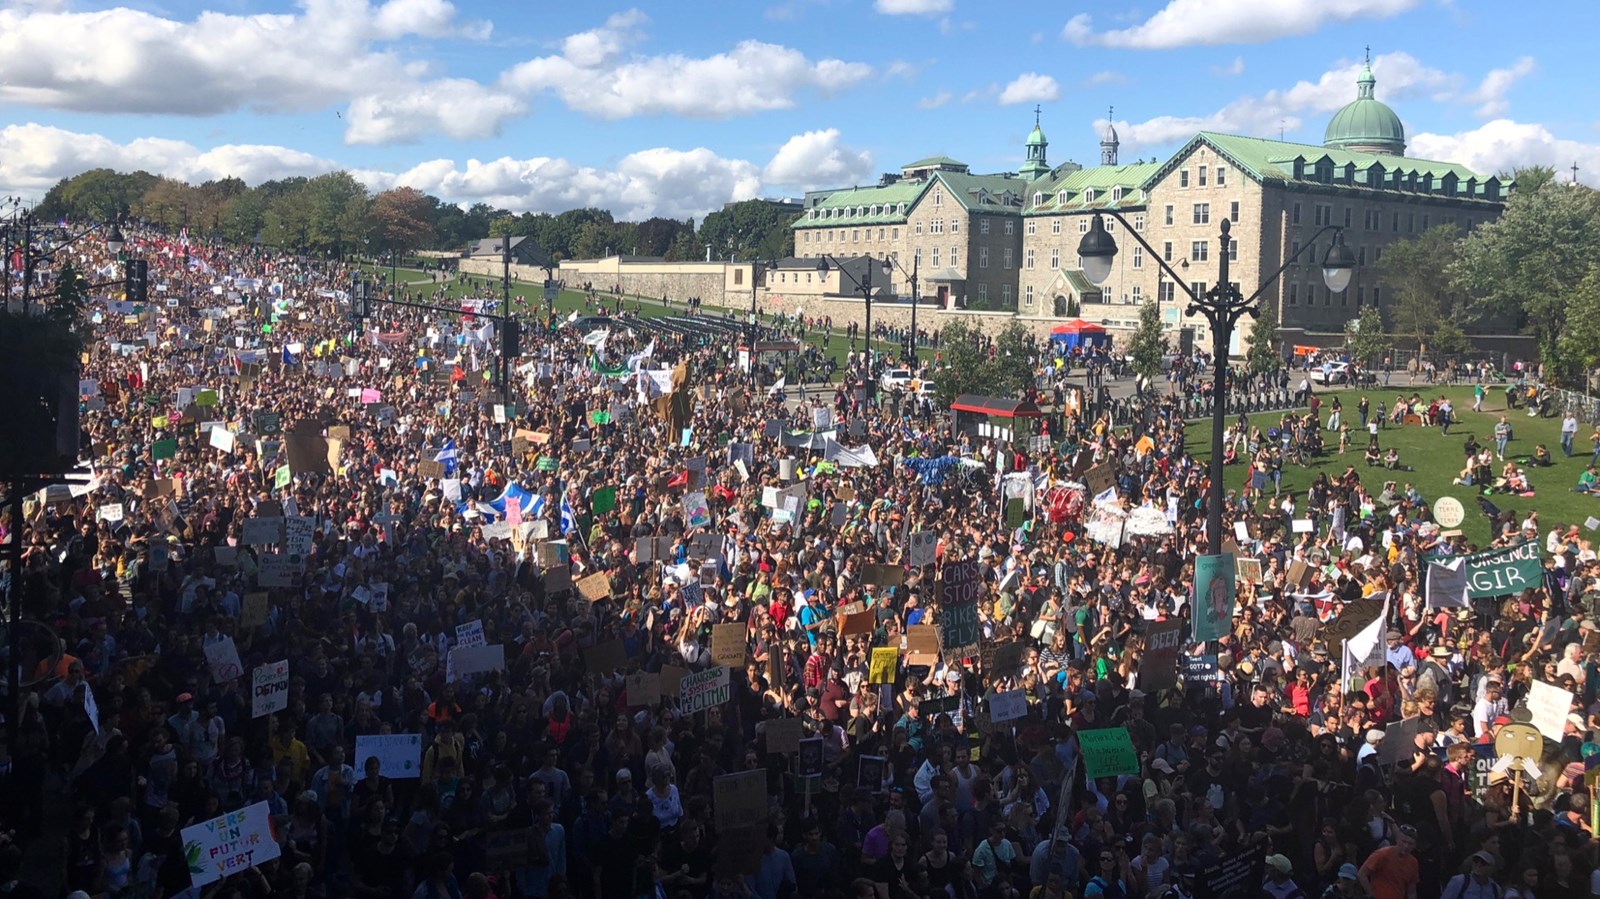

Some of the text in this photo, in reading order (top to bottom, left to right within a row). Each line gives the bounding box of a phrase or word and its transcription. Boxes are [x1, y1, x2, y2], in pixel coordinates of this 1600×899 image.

[943, 560, 979, 585] CARS
[943, 581, 978, 605] STOP
[944, 603, 978, 629] BIKES
[459, 633, 482, 646] CLEAN
[948, 623, 976, 647] FLY
[1151, 628, 1181, 650] BEER
[681, 666, 724, 690] CHANGEONS
[693, 684, 731, 710] CLIMAT
[205, 811, 246, 833] VERS
[219, 826, 241, 842] UN
[209, 832, 260, 859] FUTUR
[216, 849, 255, 871] VERT
